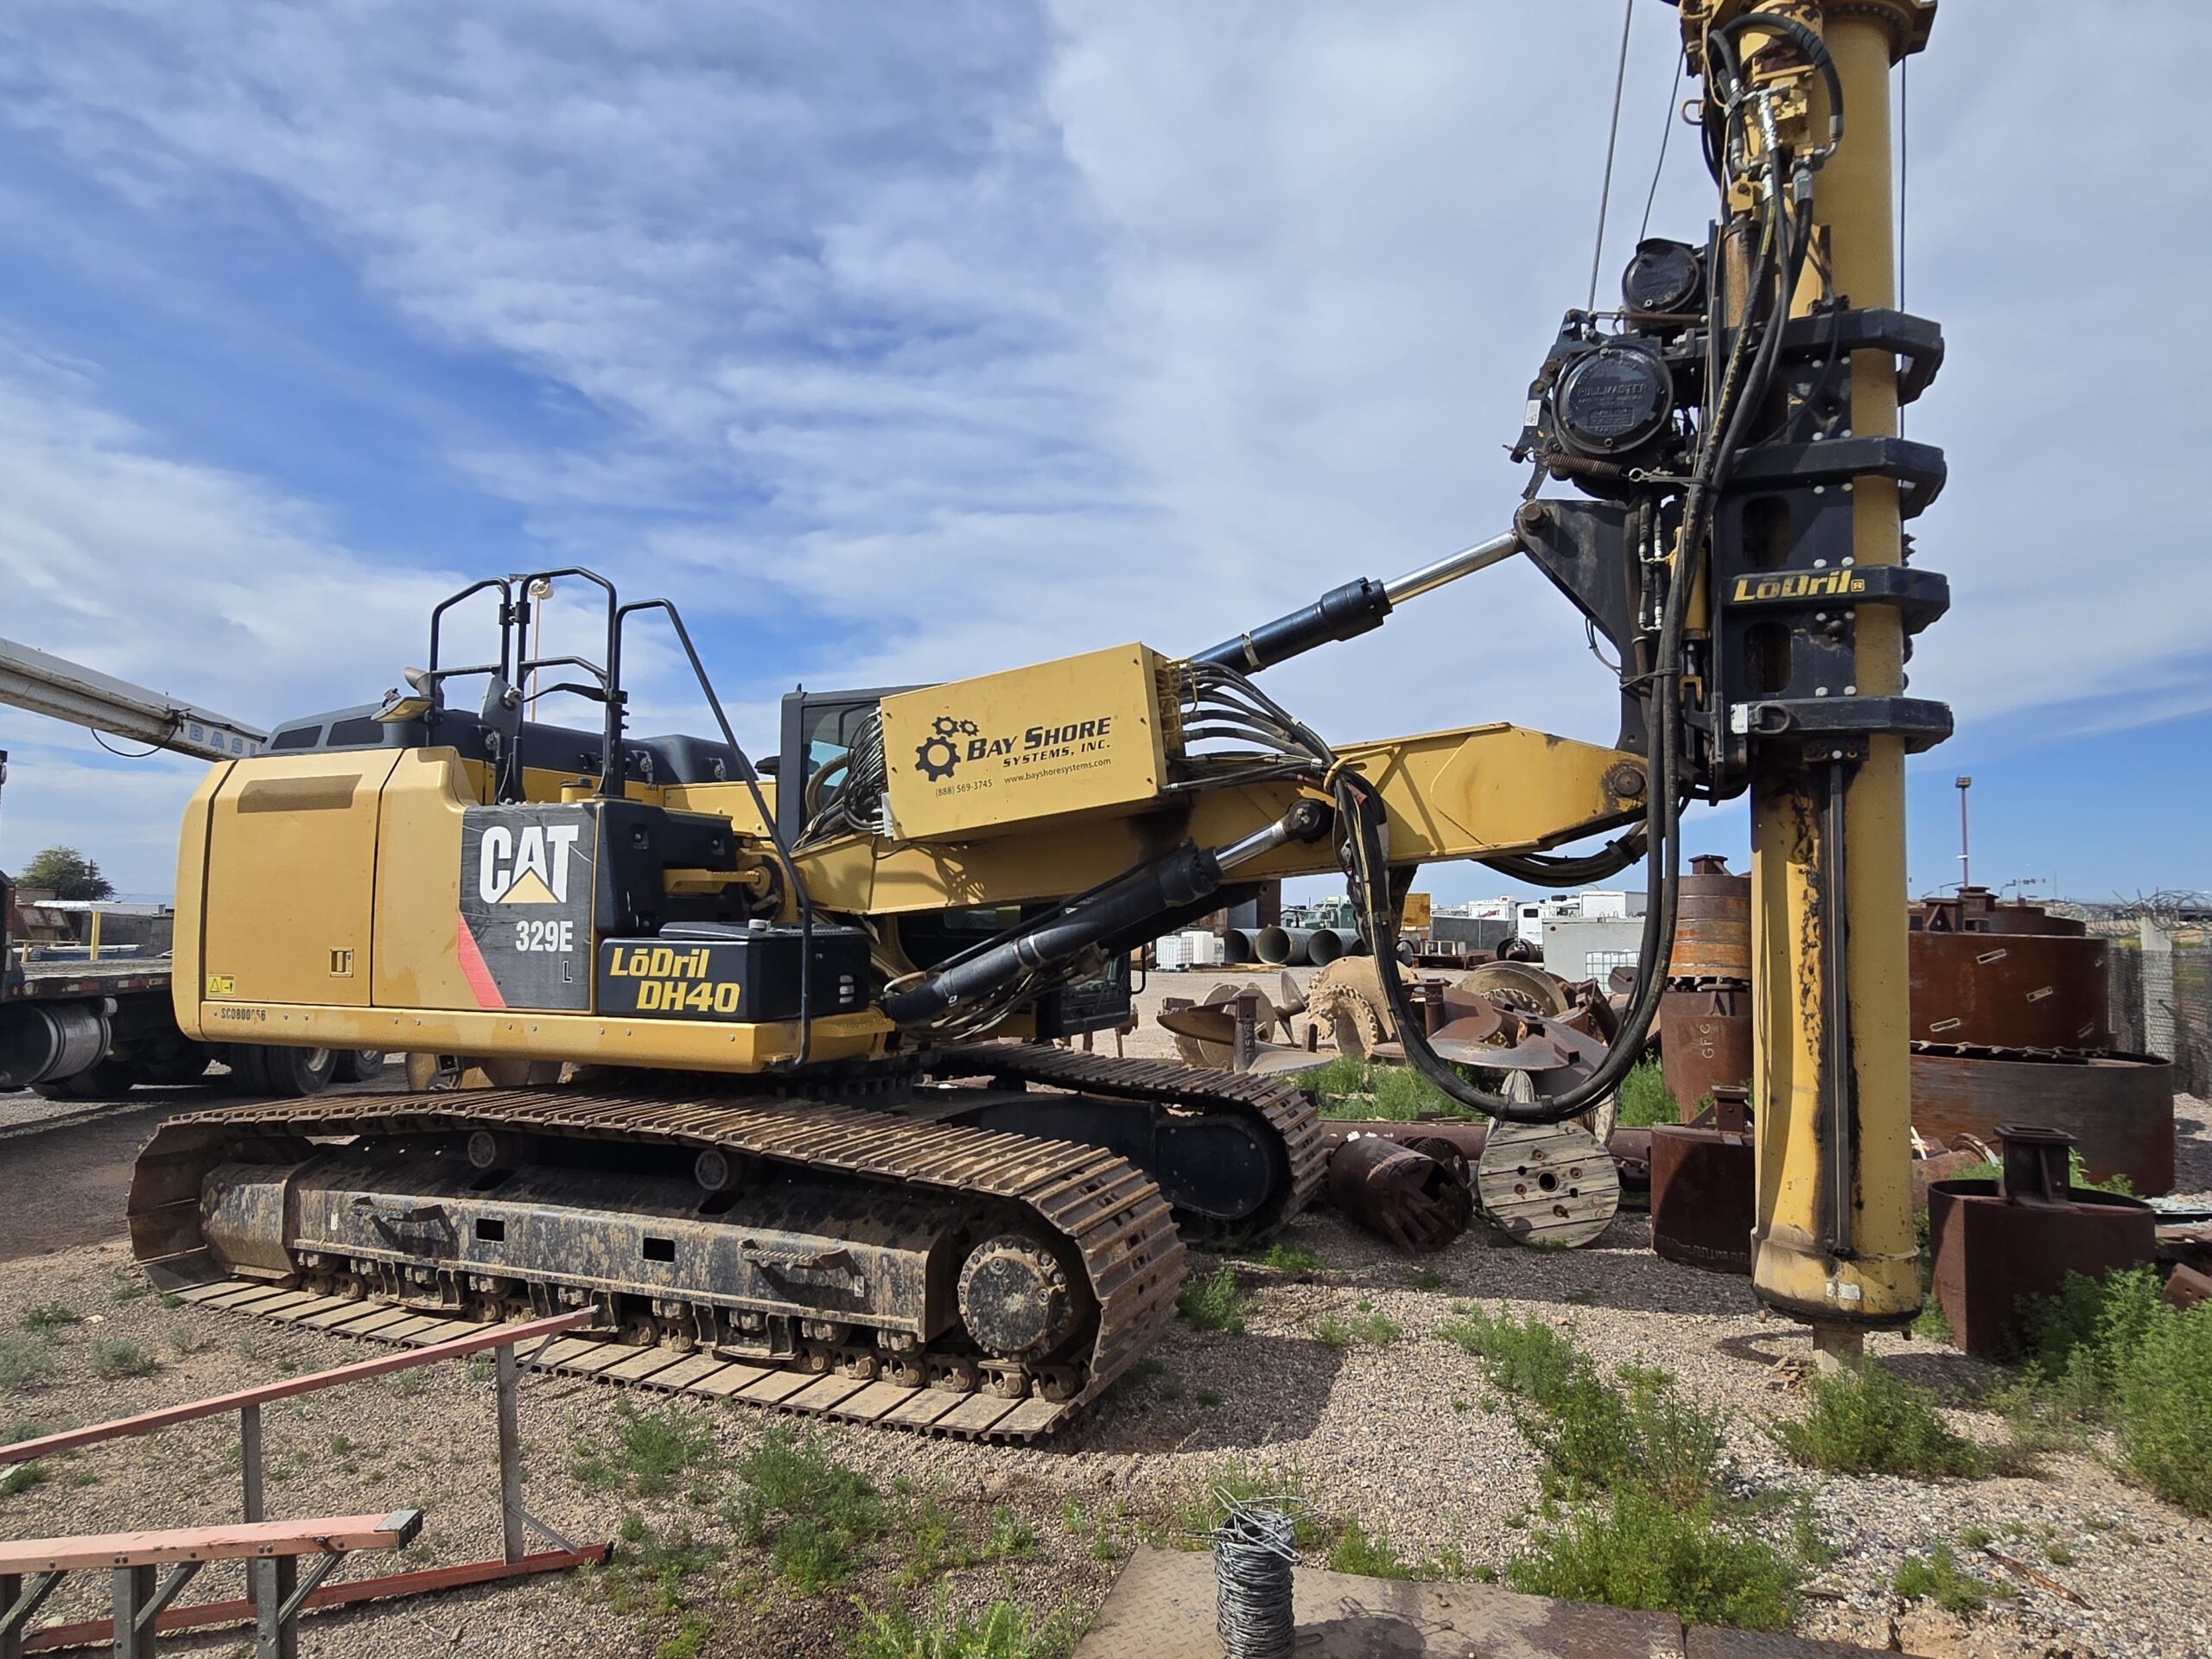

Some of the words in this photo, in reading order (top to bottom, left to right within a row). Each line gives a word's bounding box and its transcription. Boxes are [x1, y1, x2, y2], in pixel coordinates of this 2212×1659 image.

[967, 735, 1018, 762] BAY
[1024, 716, 1112, 751] SHORE
[1003, 746, 1075, 768] SYSTEMS,
[1081, 739, 1111, 753] INC.
[935, 785, 956, 798] (888)
[957, 779, 993, 793] 569-3745
[1004, 758, 1112, 785] www.bayshoresystems.com
[480, 824, 580, 904] CAT
[515, 920, 574, 952] 329E
[563, 960, 573, 983] L
[636, 980, 741, 1013] DH40
